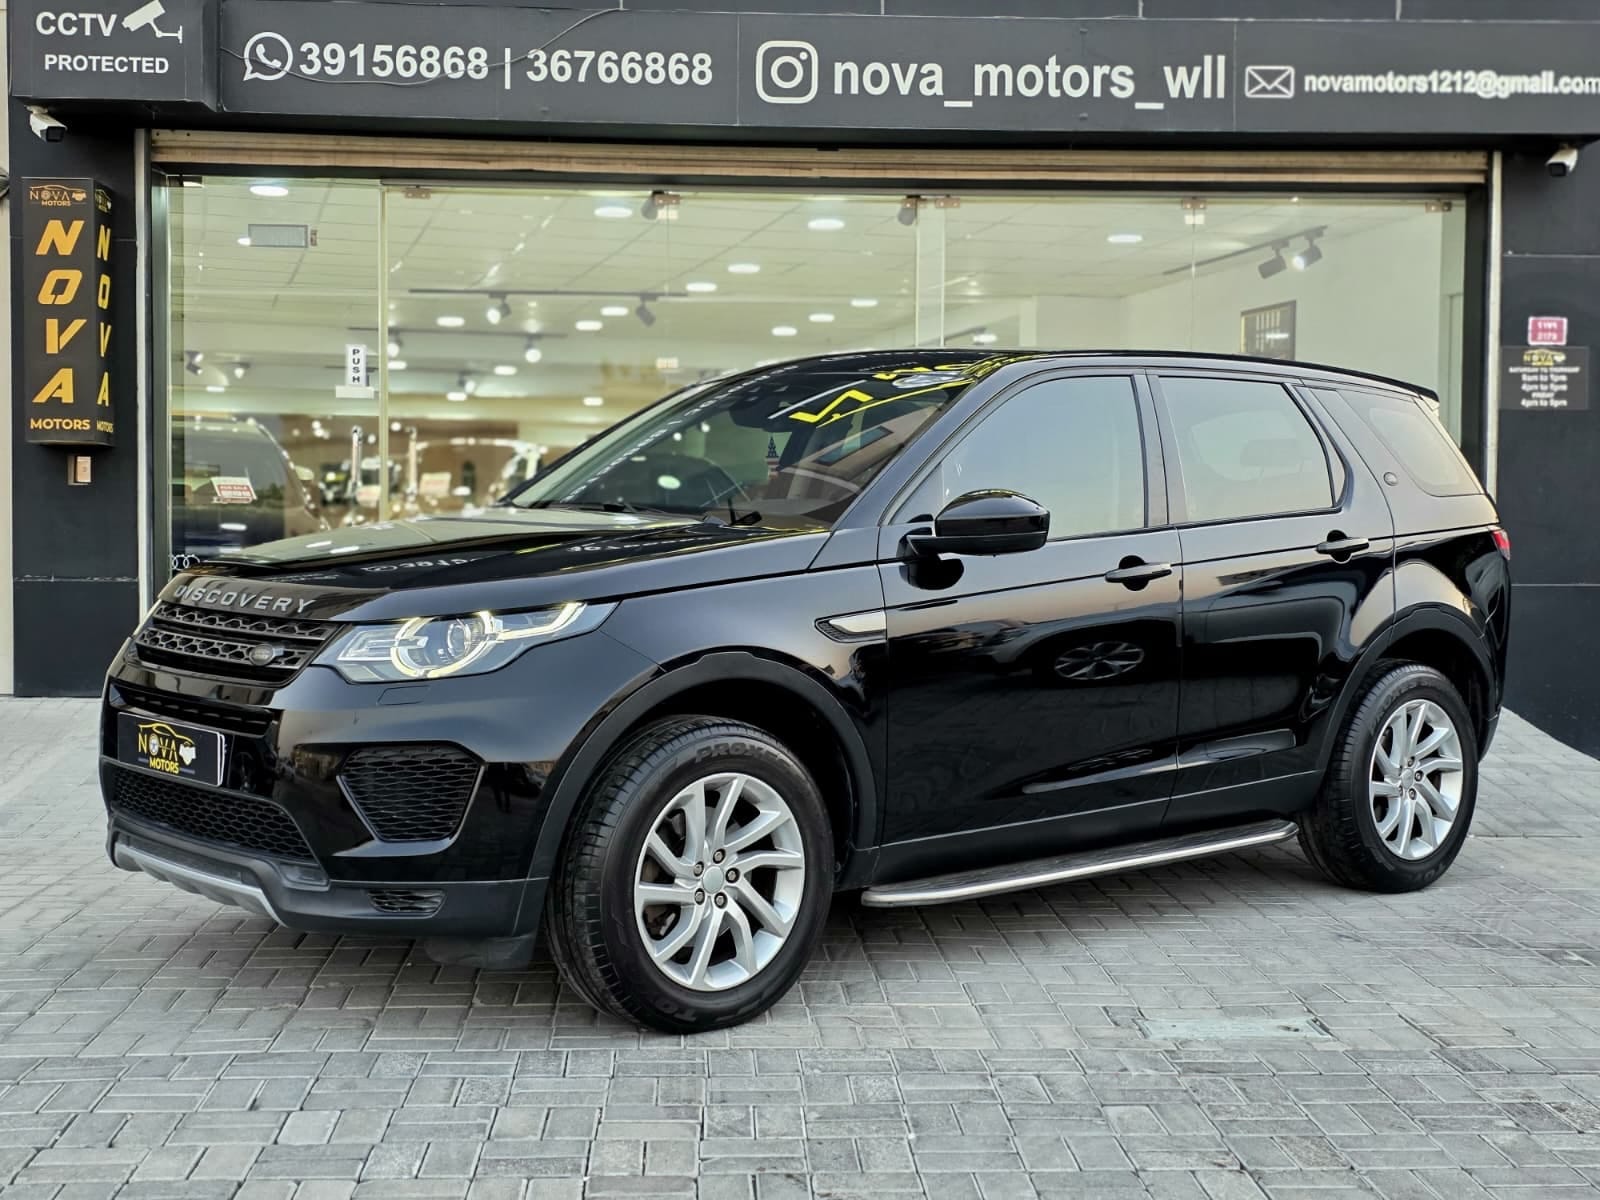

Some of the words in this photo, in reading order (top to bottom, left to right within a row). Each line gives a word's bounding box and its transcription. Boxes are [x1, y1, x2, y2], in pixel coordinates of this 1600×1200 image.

[35, 11, 118, 38] CCTV
[43, 53, 170, 75] PROTECTED
[298, 41, 490, 80] 39156868
[525, 48, 714, 86] 36766868
[832, 53, 1226, 110] nova_motors_wll
[29, 190, 71, 201] NOVA
[352, 348, 361, 383] PUSH
[29, 418, 91, 431] MOTORS
[174, 586, 316, 613] DISCOVERY
[138, 732, 178, 762] NOVA
[149, 756, 179, 774] MOTORS
